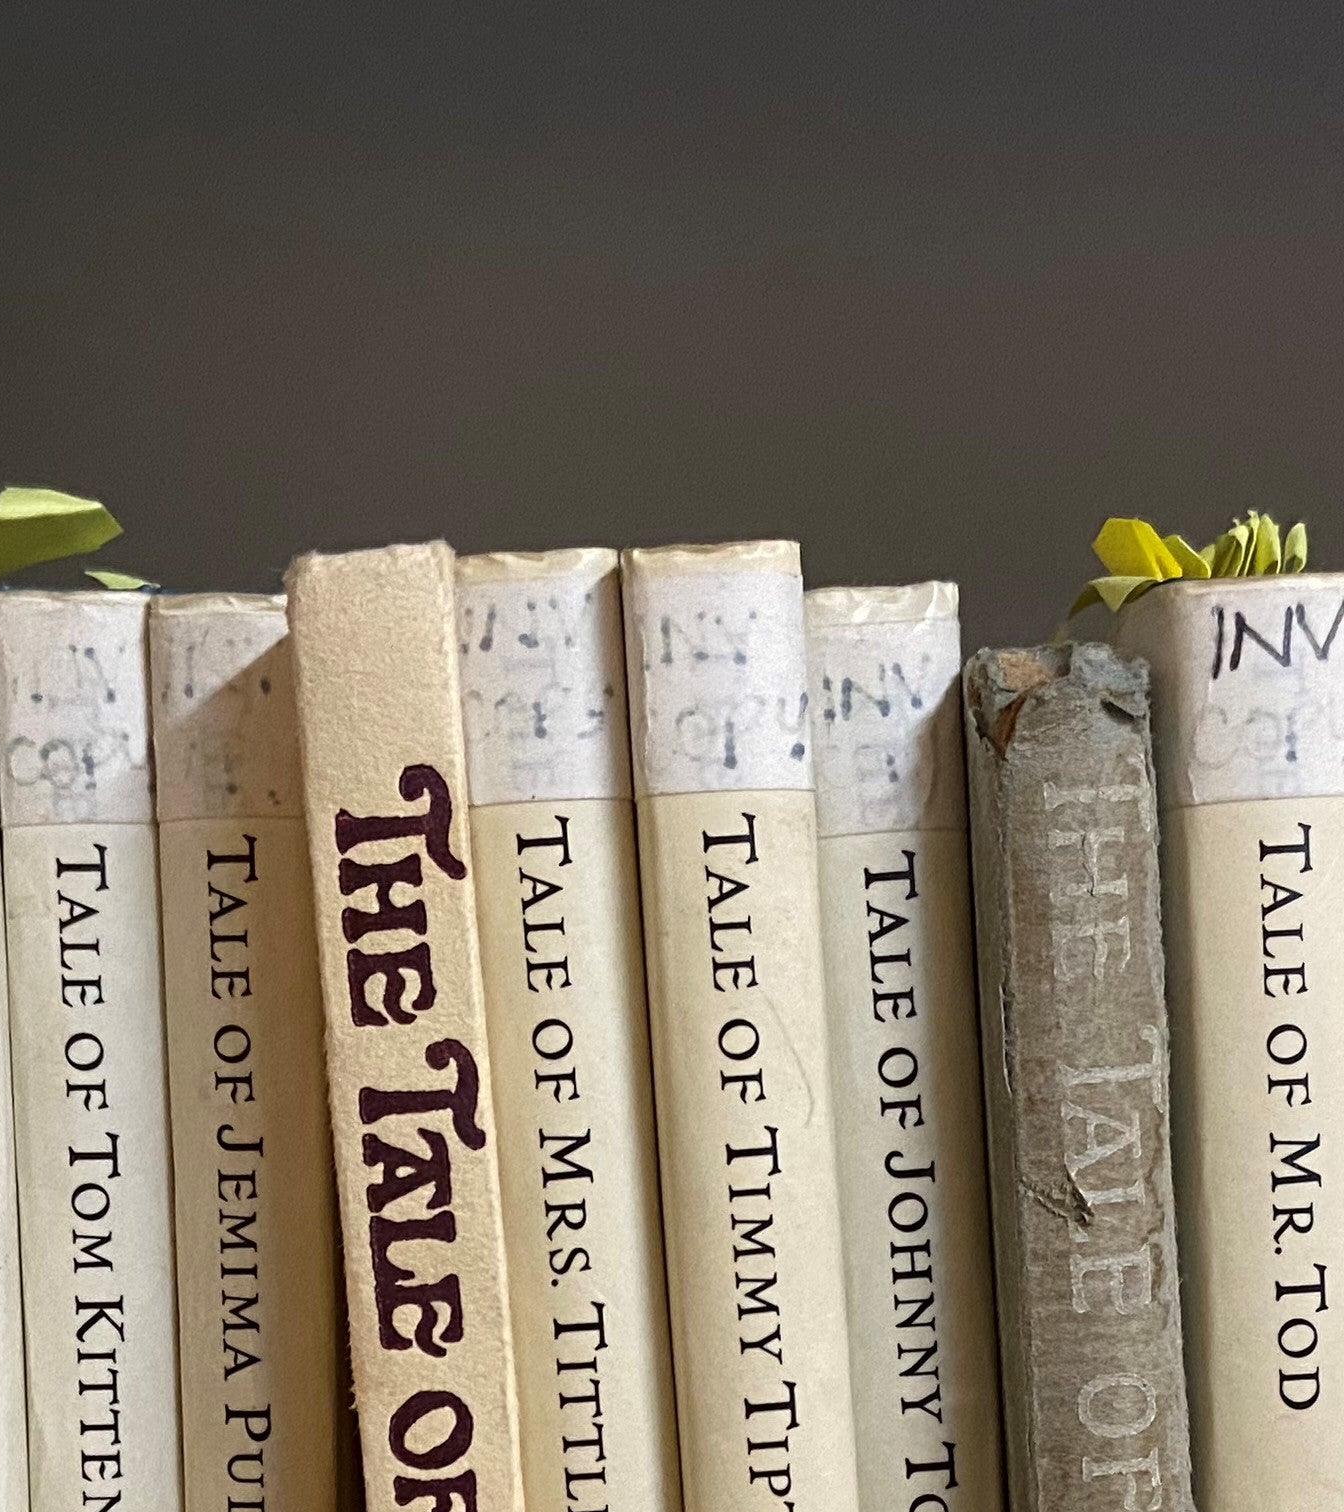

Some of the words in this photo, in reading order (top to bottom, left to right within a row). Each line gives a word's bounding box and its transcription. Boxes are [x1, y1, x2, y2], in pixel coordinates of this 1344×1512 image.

[55, 842, 110, 1010] TALE
[206, 834, 258, 1002] TALE
[334, 764, 467, 1027] THE
[515, 815, 574, 994] TALE
[702, 812, 759, 992] TALE
[863, 850, 918, 1022] TALE
[1044, 755, 1151, 982] THE
[1258, 823, 1313, 998] TALE
[63, 1031, 110, 1113] OF
[211, 1027, 258, 1106] OF
[531, 1017, 583, 1103] OF
[716, 1018, 768, 1106] OF
[876, 1046, 925, 1131] OF
[1265, 1022, 1313, 1107] OF
[68, 1131, 122, 1275] TOM
[216, 1121, 264, 1382] JEMIMA
[358, 1038, 486, 1358] TALE
[538, 1128, 594, 1288] MRS.
[725, 1124, 784, 1365] TIMMY
[1062, 1024, 1165, 1316] TALE
[1269, 1133, 1322, 1256] MR.
[883, 1147, 944, 1425] JOHNNY
[1274, 1263, 1329, 1411] TOD
[1077, 1372, 1166, 1512] OF
